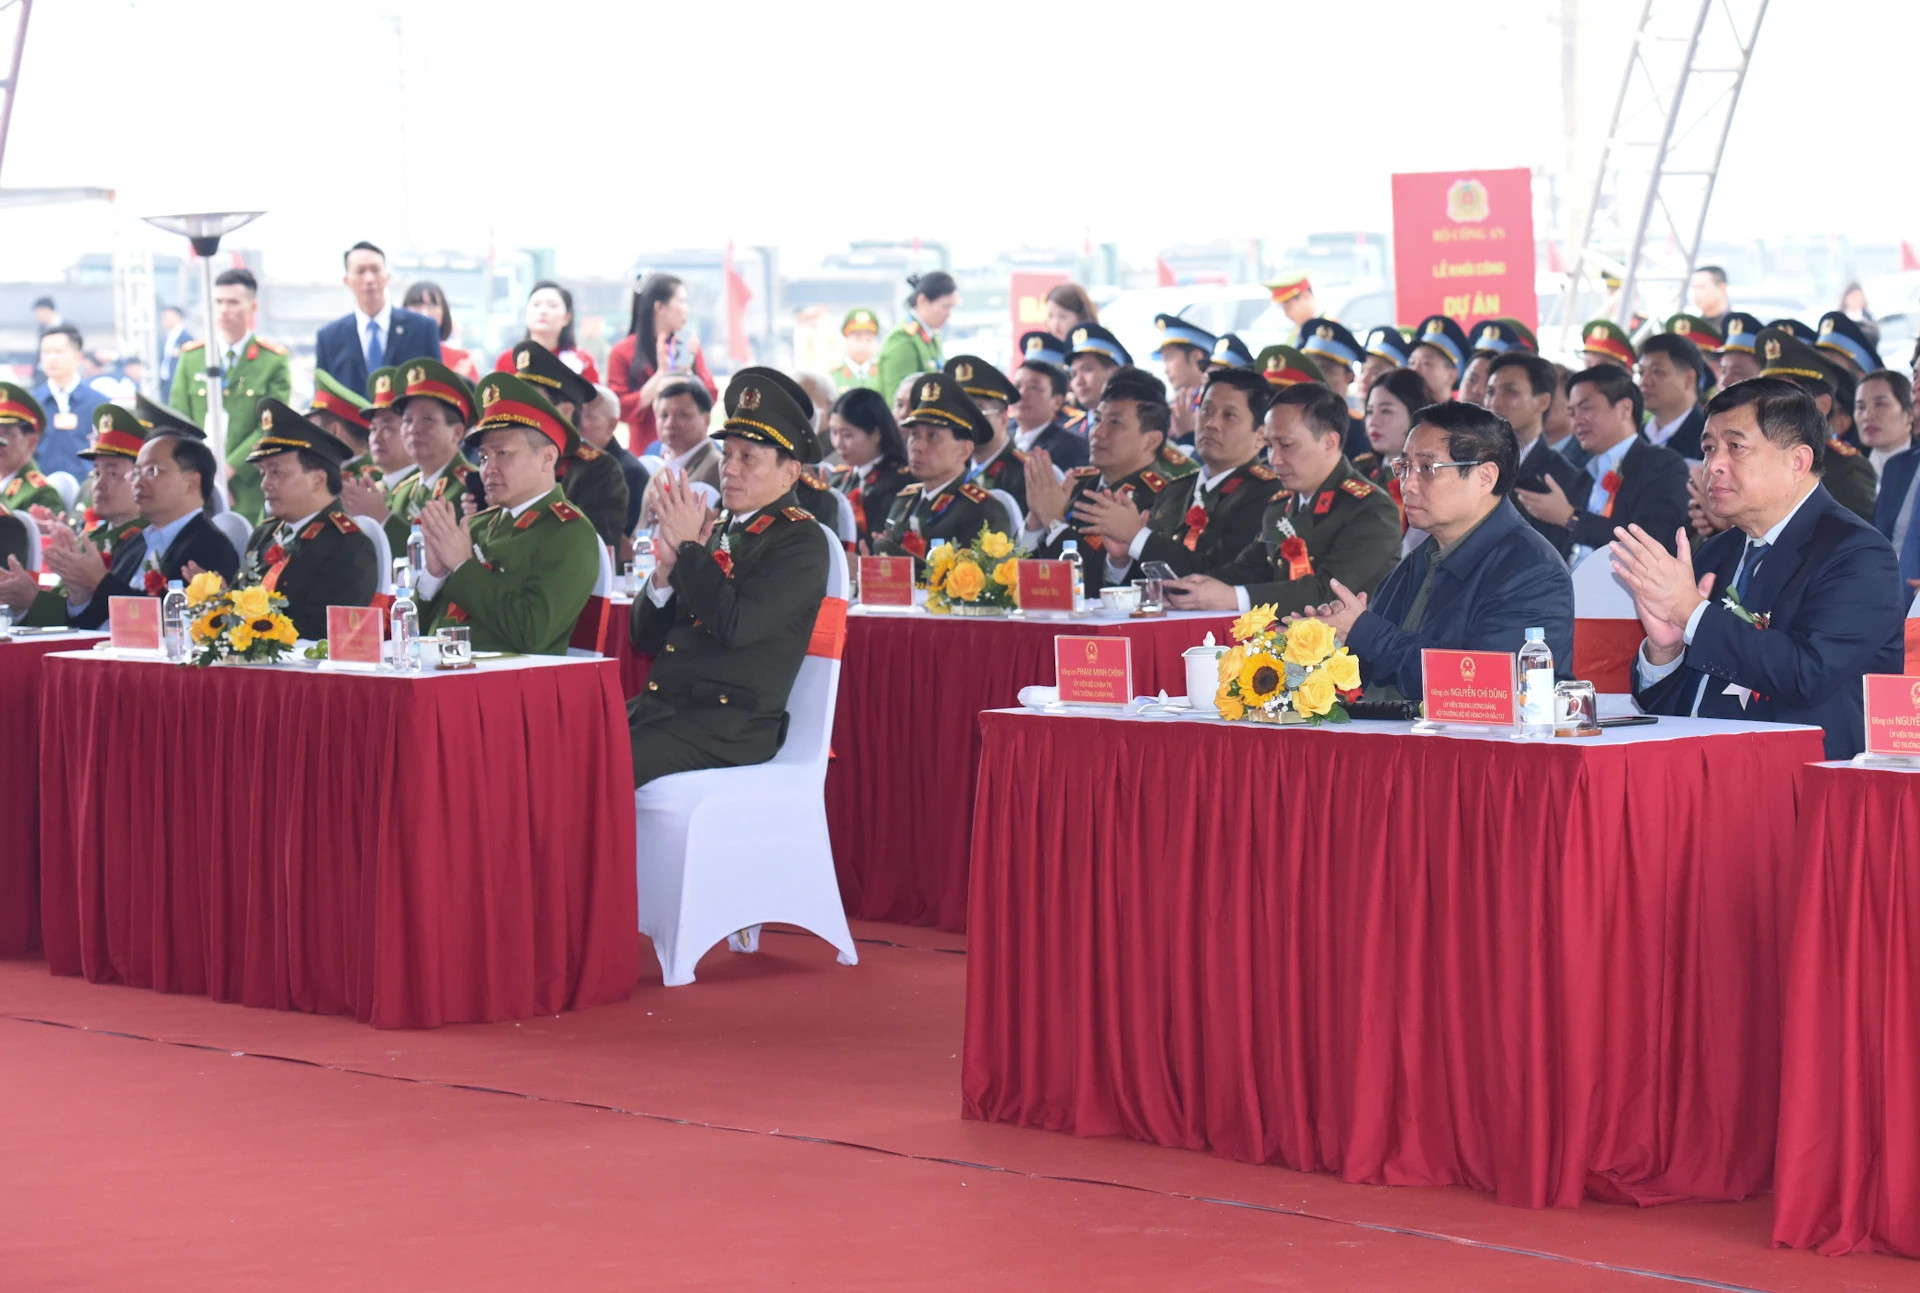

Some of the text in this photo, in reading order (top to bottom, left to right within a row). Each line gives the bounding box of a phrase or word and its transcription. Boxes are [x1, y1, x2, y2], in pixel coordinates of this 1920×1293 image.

[1444, 290, 1500, 322] DỰ ÁN
[1076, 668, 1092, 677] PHẠM
[1093, 668, 1107, 676] MINH
[1108, 667, 1124, 677] CHÍNH
[1431, 688, 1442, 697] Đồng
[1450, 685, 1476, 697] NGUYỄN
[1477, 687, 1488, 698] CHÍ
[1489, 688, 1508, 699] DŨNG
[1872, 716, 1885, 726] Đồng
